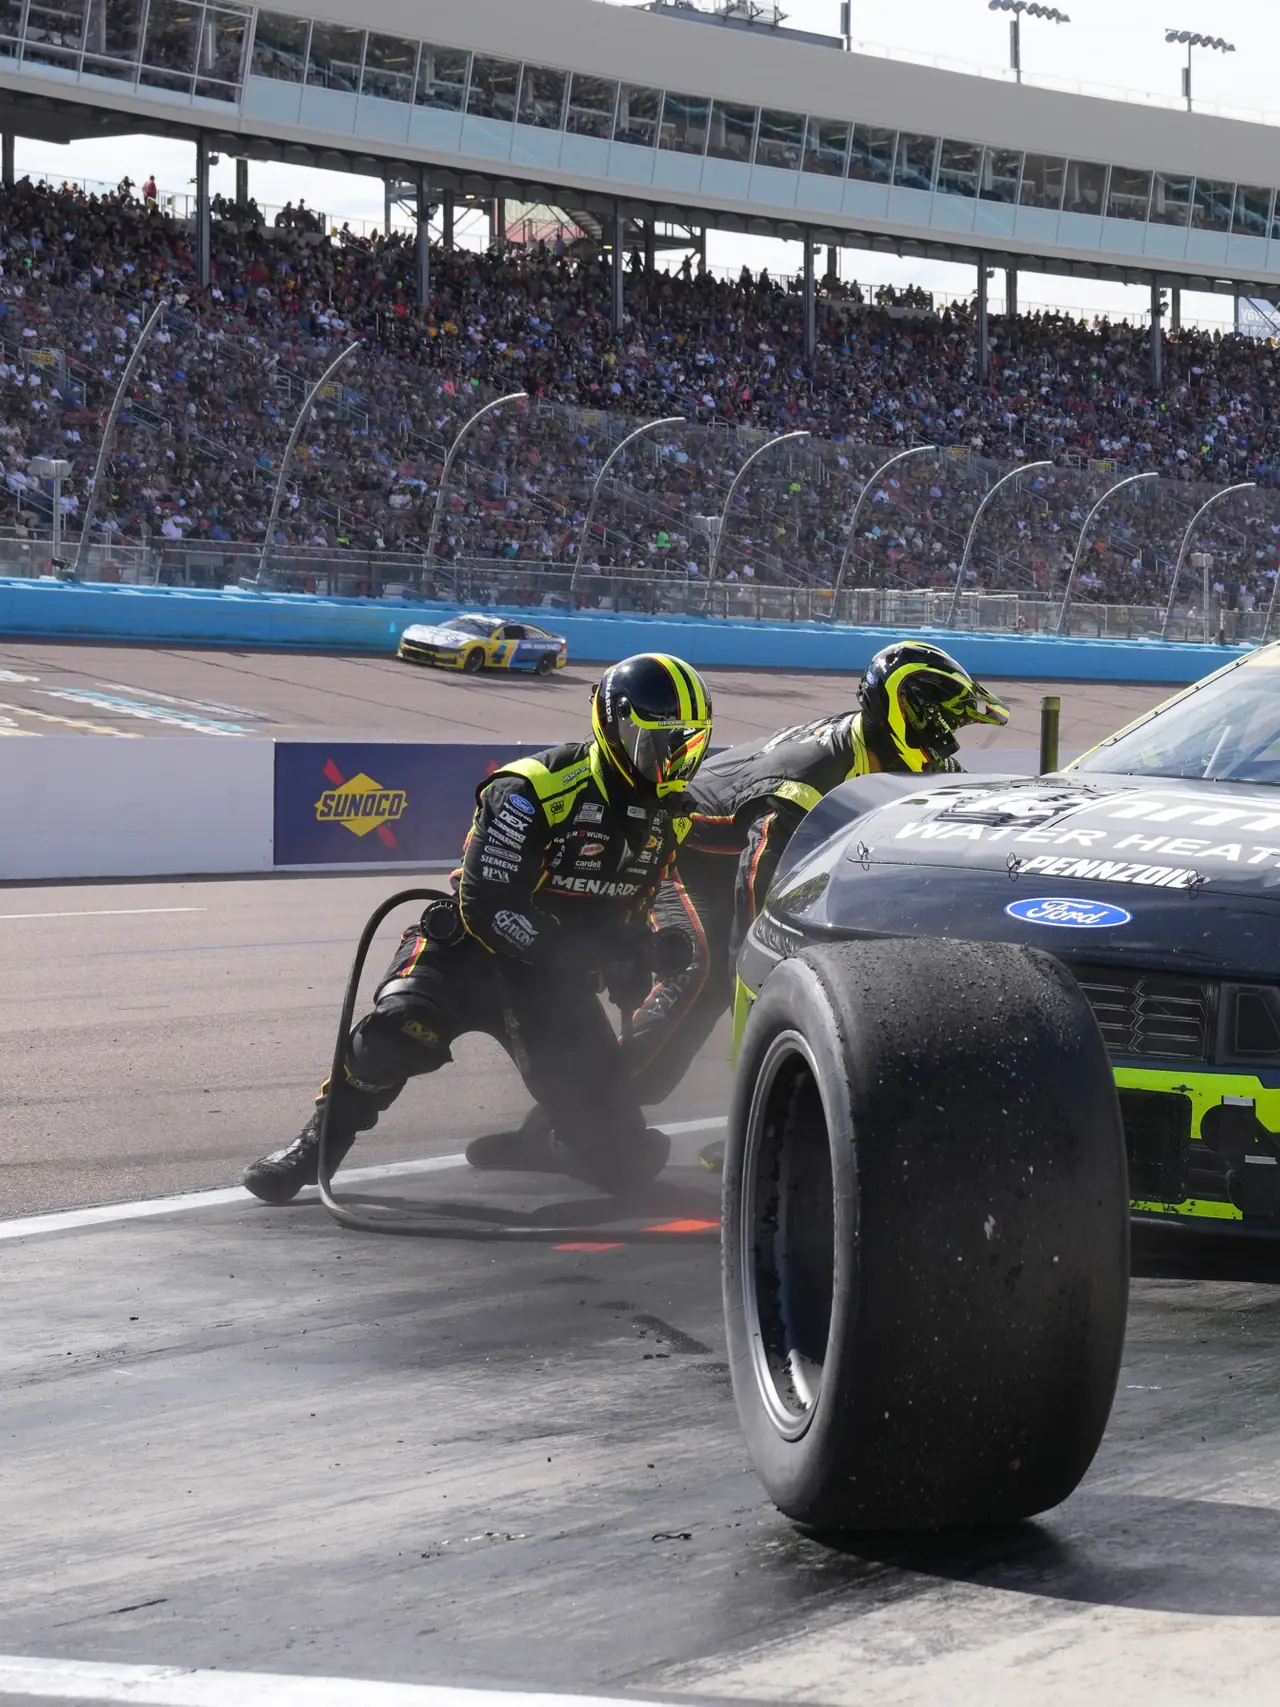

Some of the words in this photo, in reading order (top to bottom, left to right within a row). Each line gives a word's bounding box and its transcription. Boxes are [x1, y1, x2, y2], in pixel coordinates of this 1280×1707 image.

[605, 668, 616, 723] MENARDS
[318, 792, 405, 818] SUNOCO
[503, 802, 533, 823] RACING
[499, 810, 529, 831] DEX
[895, 822, 1107, 847] WATER
[480, 855, 519, 872] SIEMENS
[575, 860, 601, 868] cardell
[1024, 855, 1193, 889] PENNZOIL
[552, 874, 642, 896] MENARDS
[1026, 899, 1110, 924] Ford
